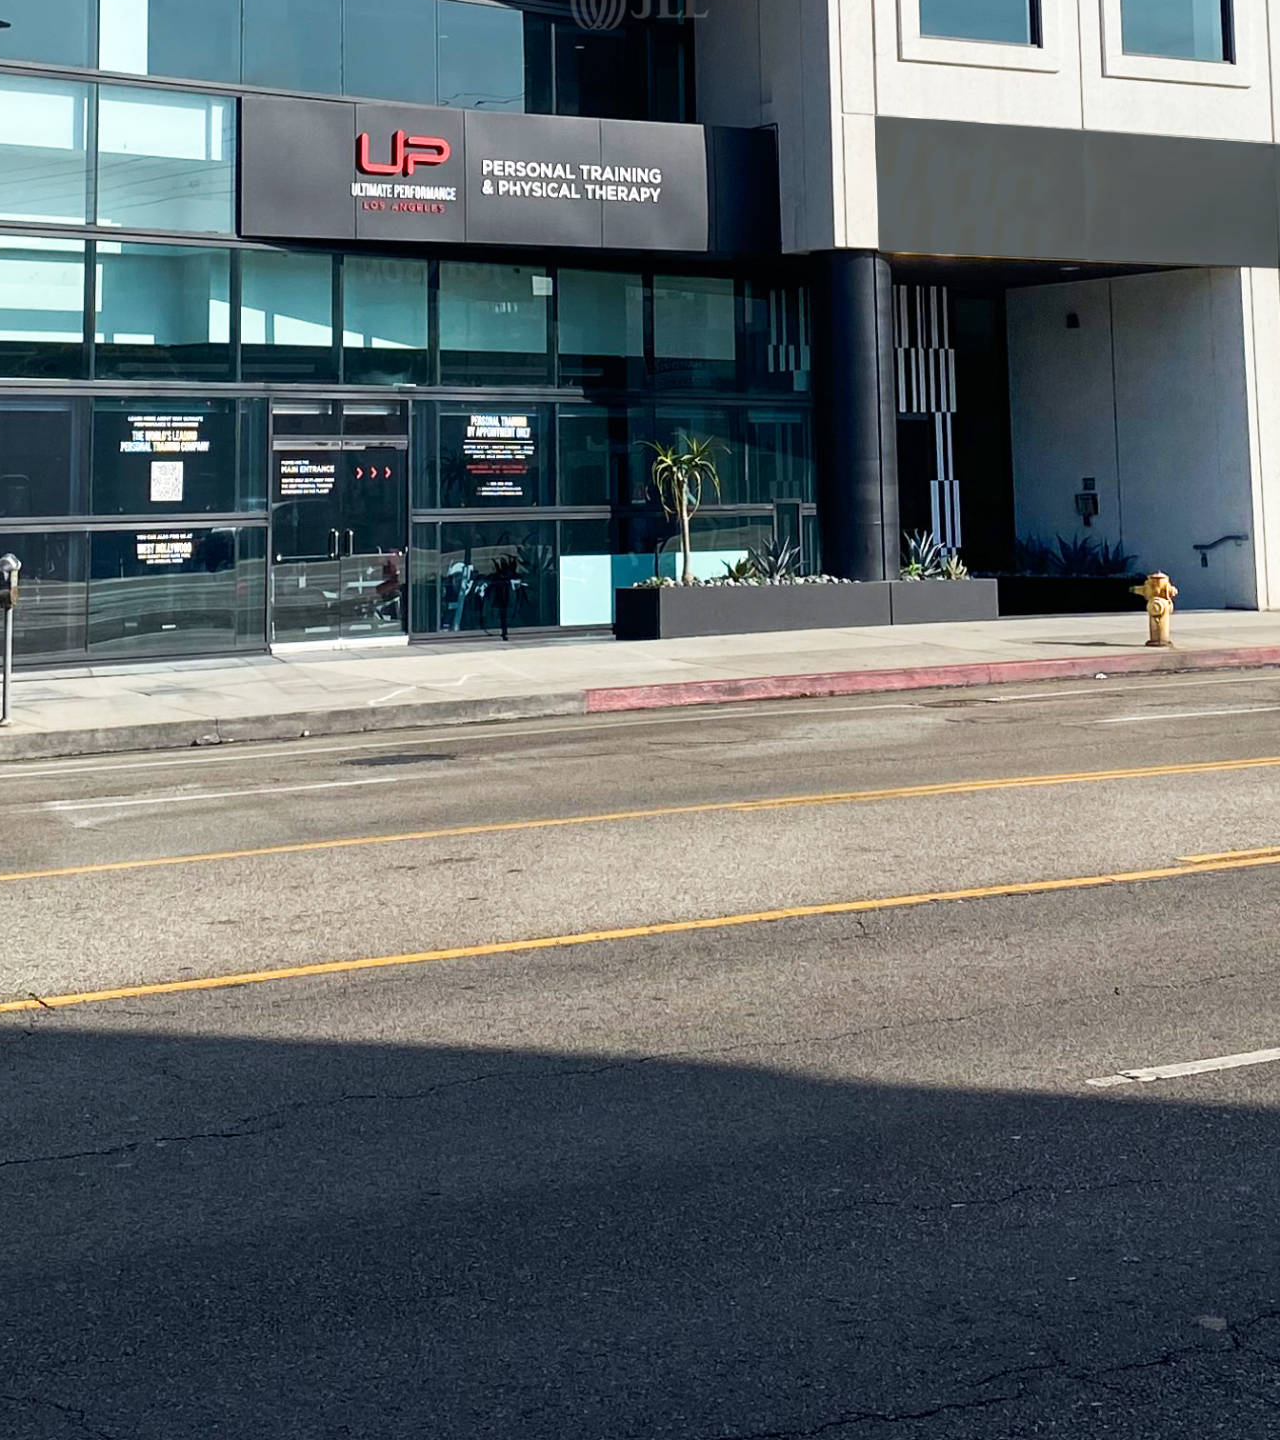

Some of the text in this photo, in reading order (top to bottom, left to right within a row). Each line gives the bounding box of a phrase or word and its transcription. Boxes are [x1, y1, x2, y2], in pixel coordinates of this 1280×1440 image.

[357, 130, 451, 177] UP
[482, 159, 662, 184] PERSONAL TRAINING
[351, 182, 457, 201] ULTIMATE PERFORMANCE
[481, 179, 662, 203] & PHYSICAL THERAPY
[363, 200, 446, 214] LOS ANGELES
[132, 430, 144, 441] THE
[281, 464, 335, 474] MAIN ENTRANCE
[155, 542, 192, 554] HOLLYWOOD
